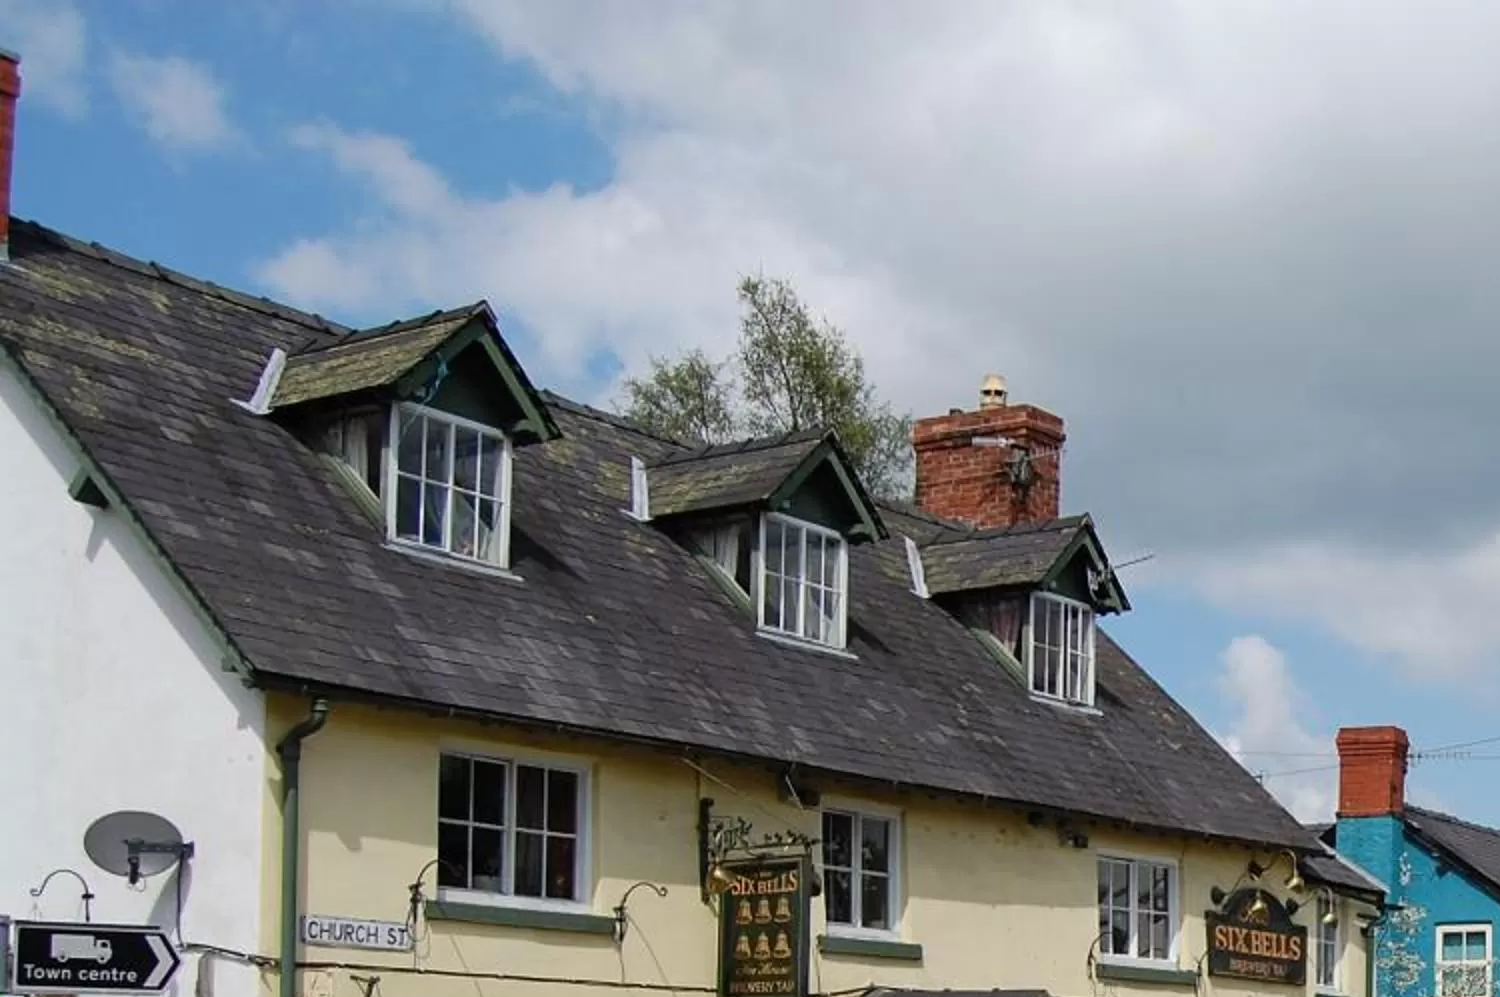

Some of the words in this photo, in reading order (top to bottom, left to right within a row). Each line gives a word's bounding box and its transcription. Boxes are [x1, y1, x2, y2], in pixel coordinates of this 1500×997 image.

[731, 875, 757, 897] SIX
[757, 870, 798, 895] BELLS
[307, 920, 379, 944] CHURCH
[387, 927, 408, 947] ST
[1215, 924, 1249, 955] SIX
[1250, 929, 1302, 961] BELLS
[23, 963, 71, 980] Town
[78, 967, 138, 982] centre
